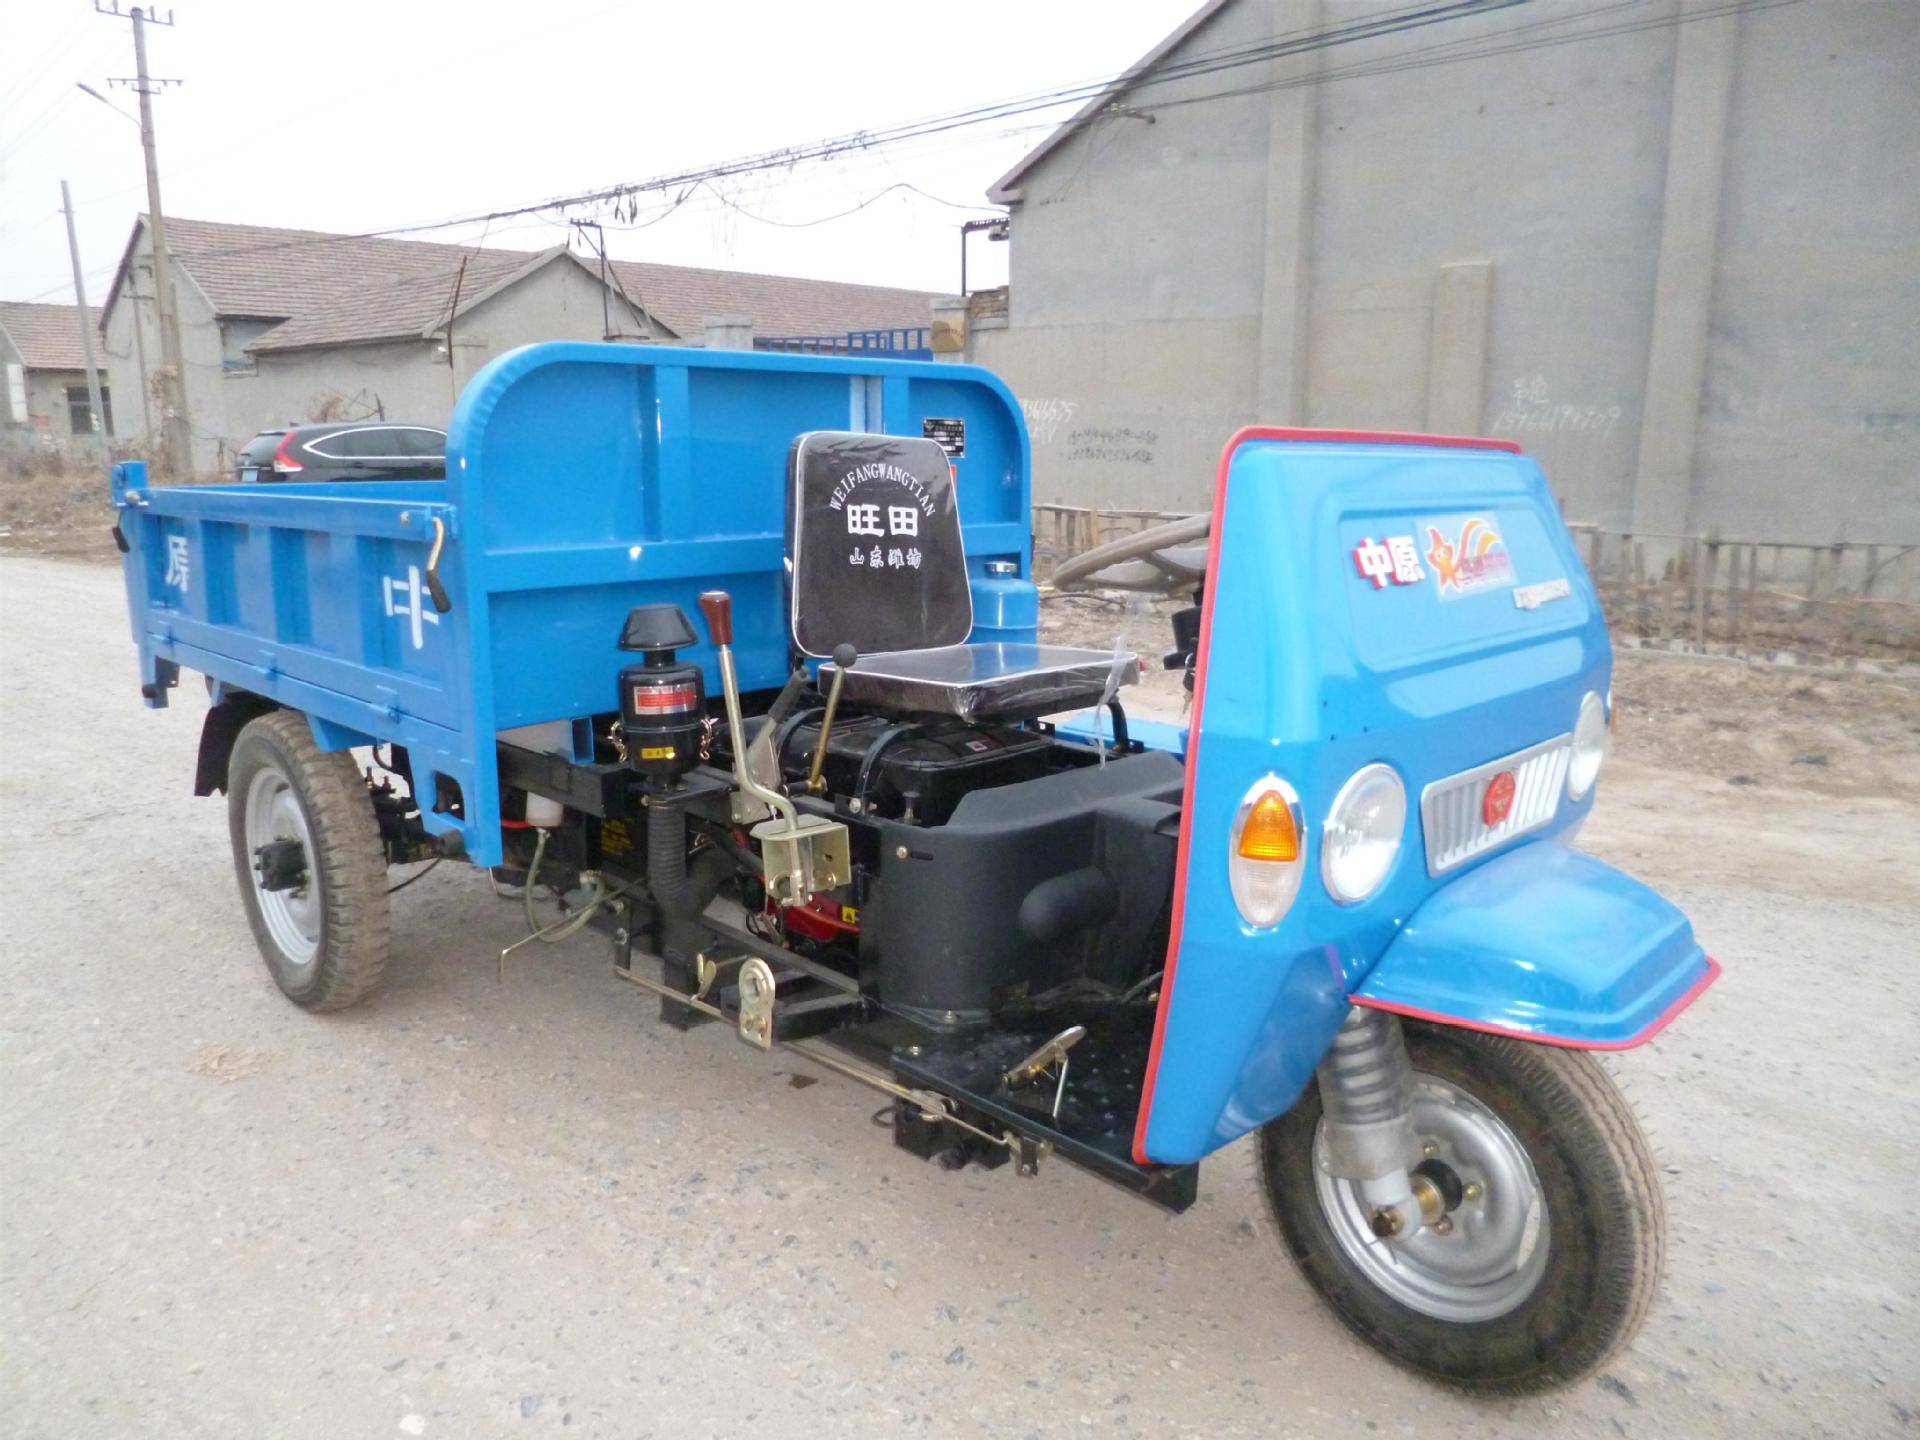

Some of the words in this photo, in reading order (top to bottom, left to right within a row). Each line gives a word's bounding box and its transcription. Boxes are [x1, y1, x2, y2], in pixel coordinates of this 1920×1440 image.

[847, 503, 919, 538] 旺田
[1353, 536, 1425, 590] 中原
[382, 564, 440, 650] 中
